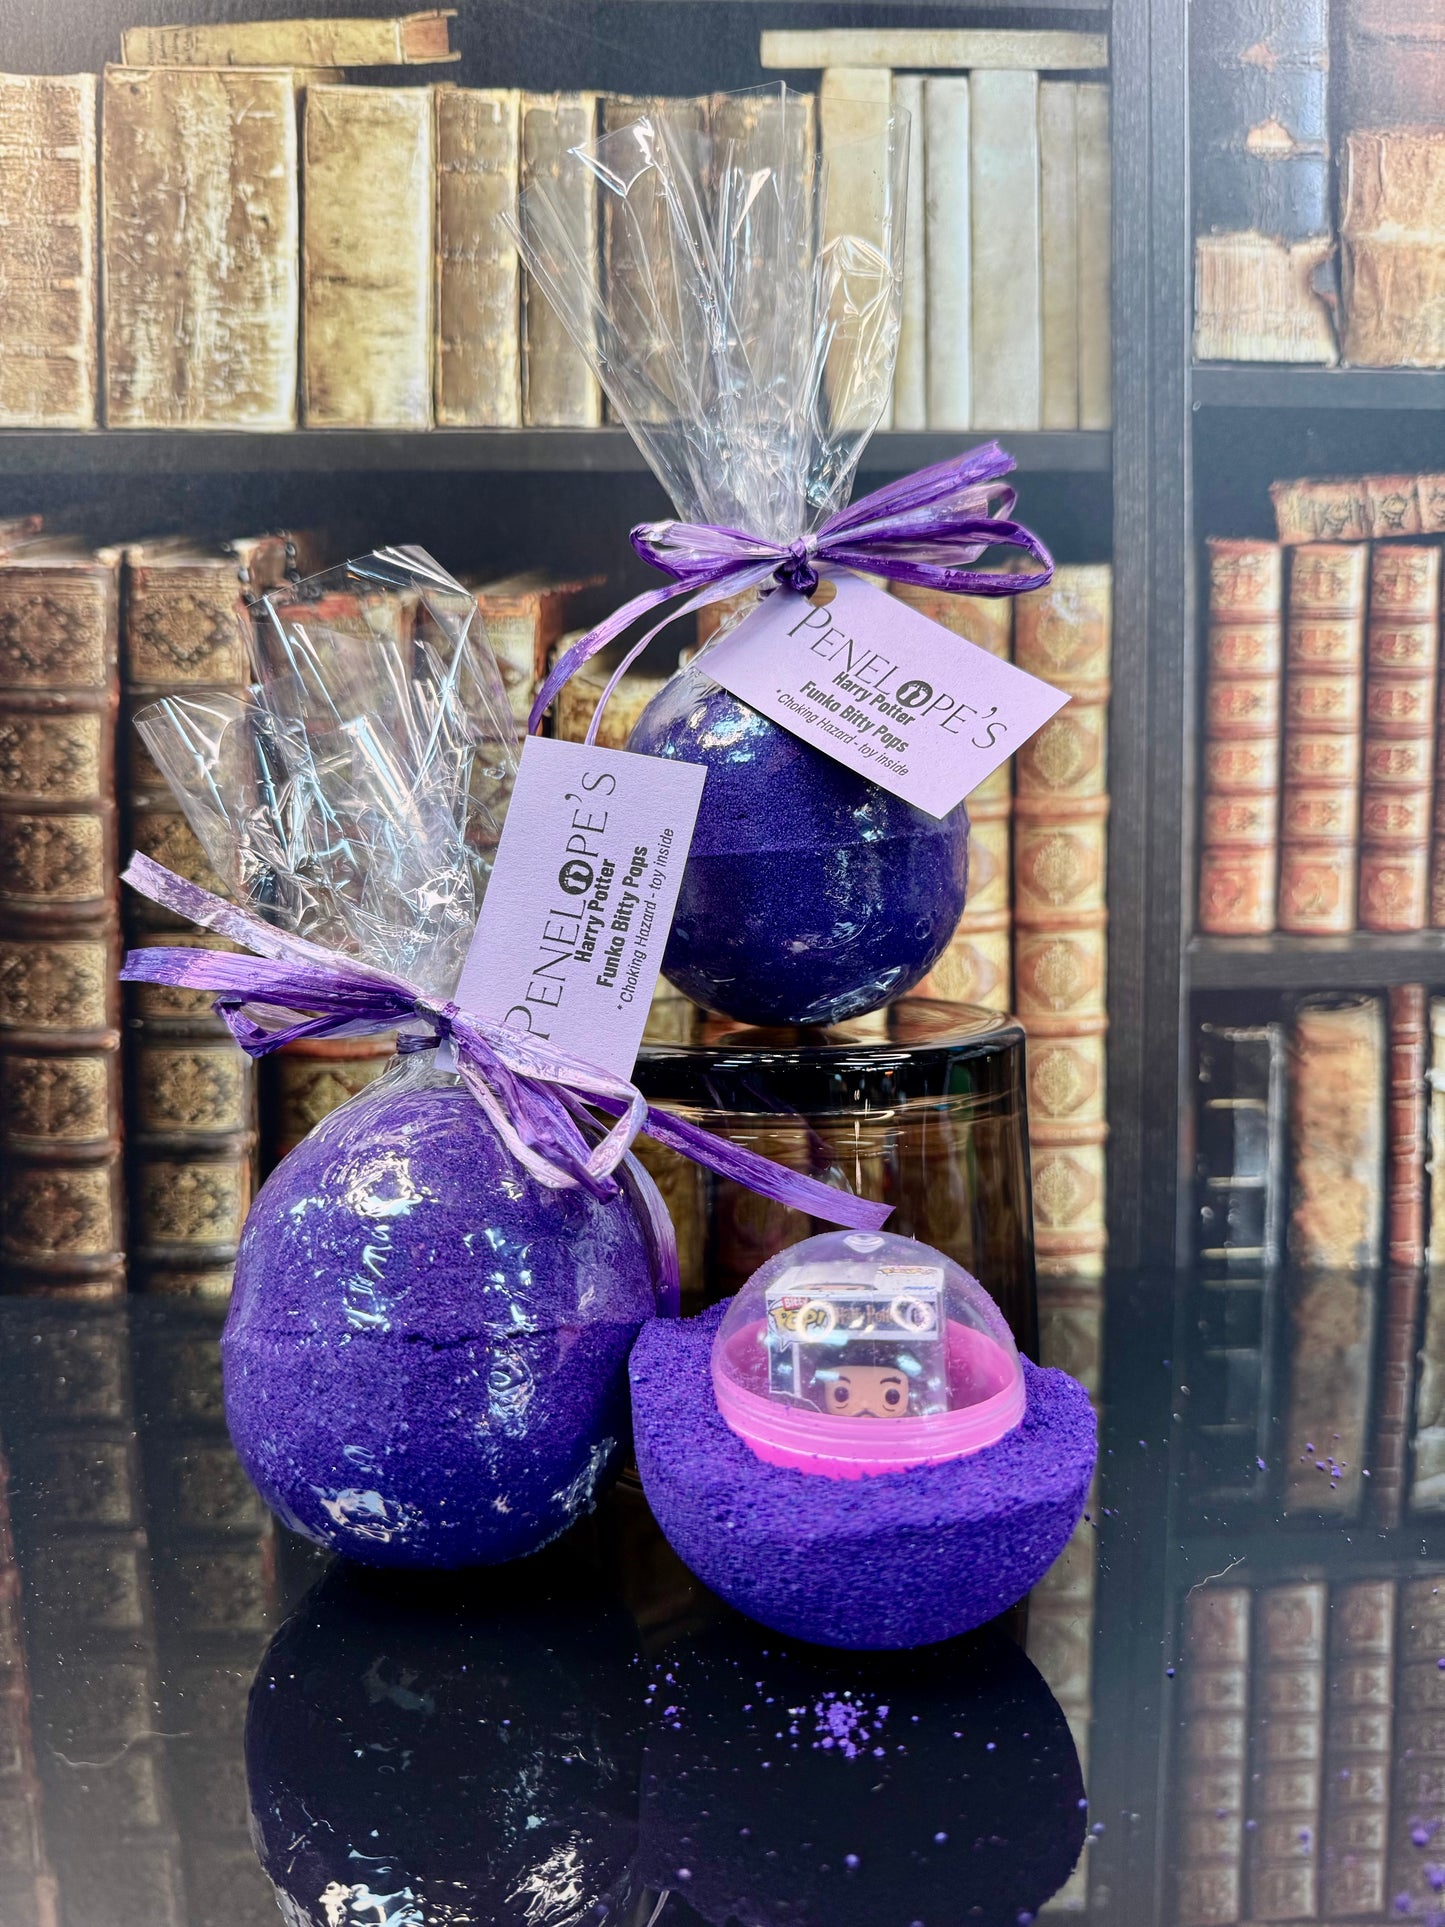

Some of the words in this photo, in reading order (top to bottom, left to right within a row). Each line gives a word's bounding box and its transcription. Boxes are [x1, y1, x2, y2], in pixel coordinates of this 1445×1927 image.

[799, 680, 842, 713] Funko
[839, 706, 875, 734] Bitty
[871, 724, 909, 753] Pops
[831, 671, 873, 703] Harry
[869, 693, 916, 726] Potter
[816, 717, 856, 744] Hazard
[857, 743, 878, 759] toy
[875, 752, 909, 776] inside
[621, 846, 649, 888] Pops
[653, 828, 674, 867] inside
[587, 858, 616, 913] Potter
[648, 869, 667, 890] toy
[610, 891, 640, 932] Bitty
[633, 900, 657, 947] Hazard
[573, 914, 605, 963] Harry
[596, 936, 626, 988] Funko
